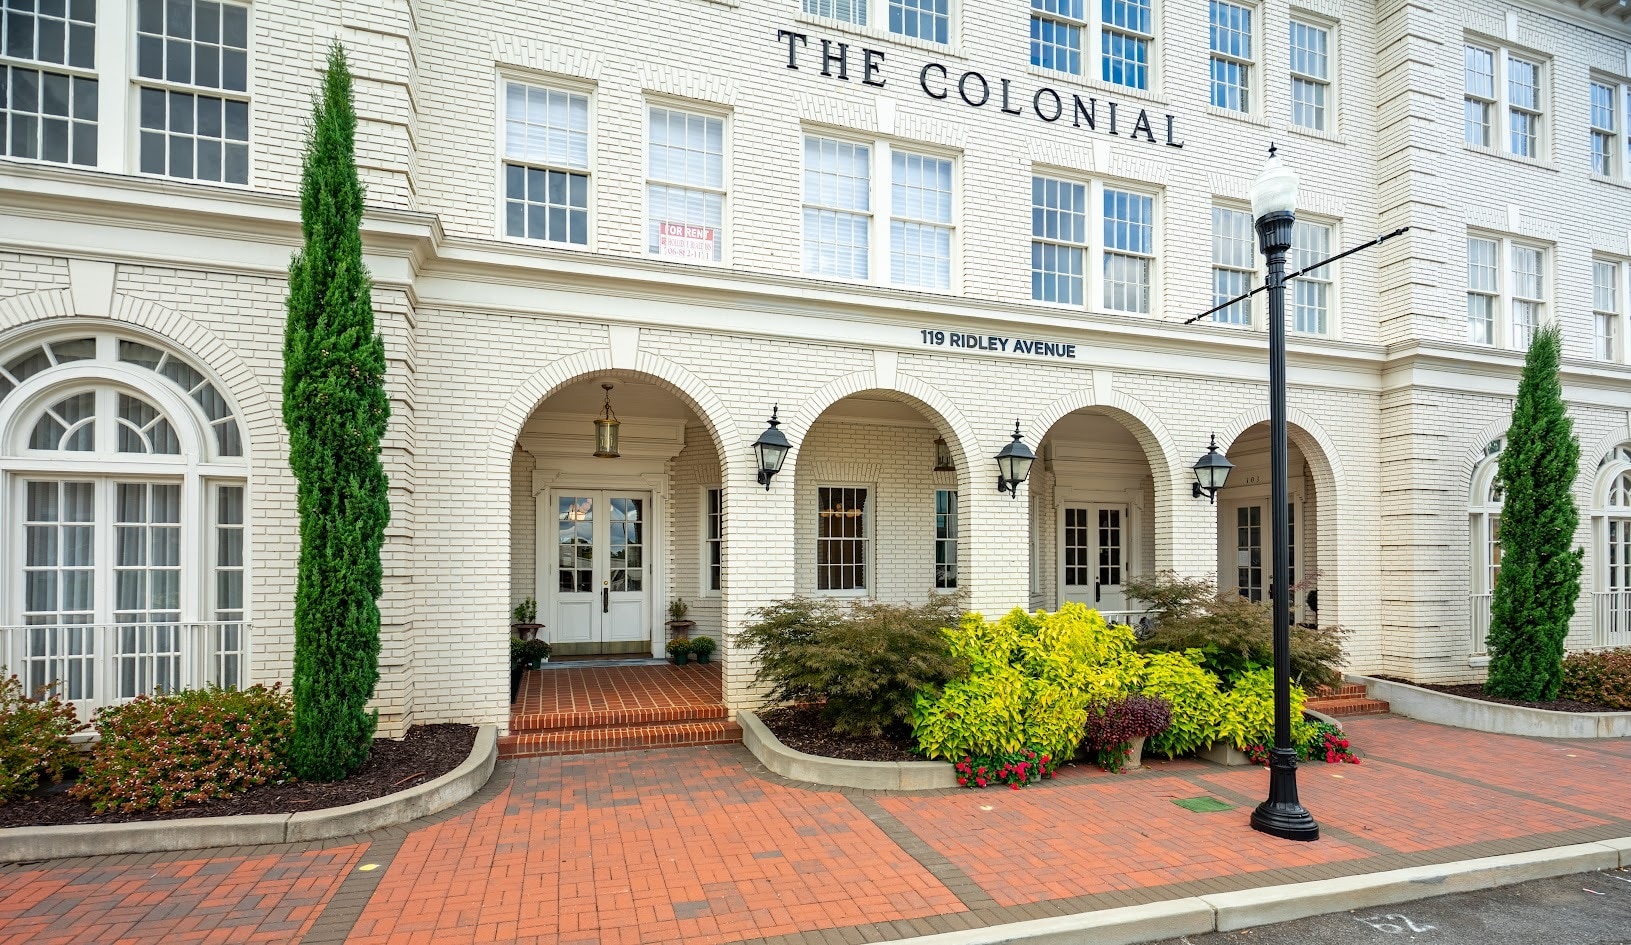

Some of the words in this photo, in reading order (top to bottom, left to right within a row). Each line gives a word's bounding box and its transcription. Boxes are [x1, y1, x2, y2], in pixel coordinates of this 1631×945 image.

[778, 29, 887, 88] THE
[919, 62, 1185, 149] COLONIAL
[665, 225, 683, 236] FOR
[686, 228, 709, 240] RENT
[920, 329, 945, 346] 119
[949, 332, 1009, 352] RIDLEY
[1013, 339, 1076, 359] AVENUE
